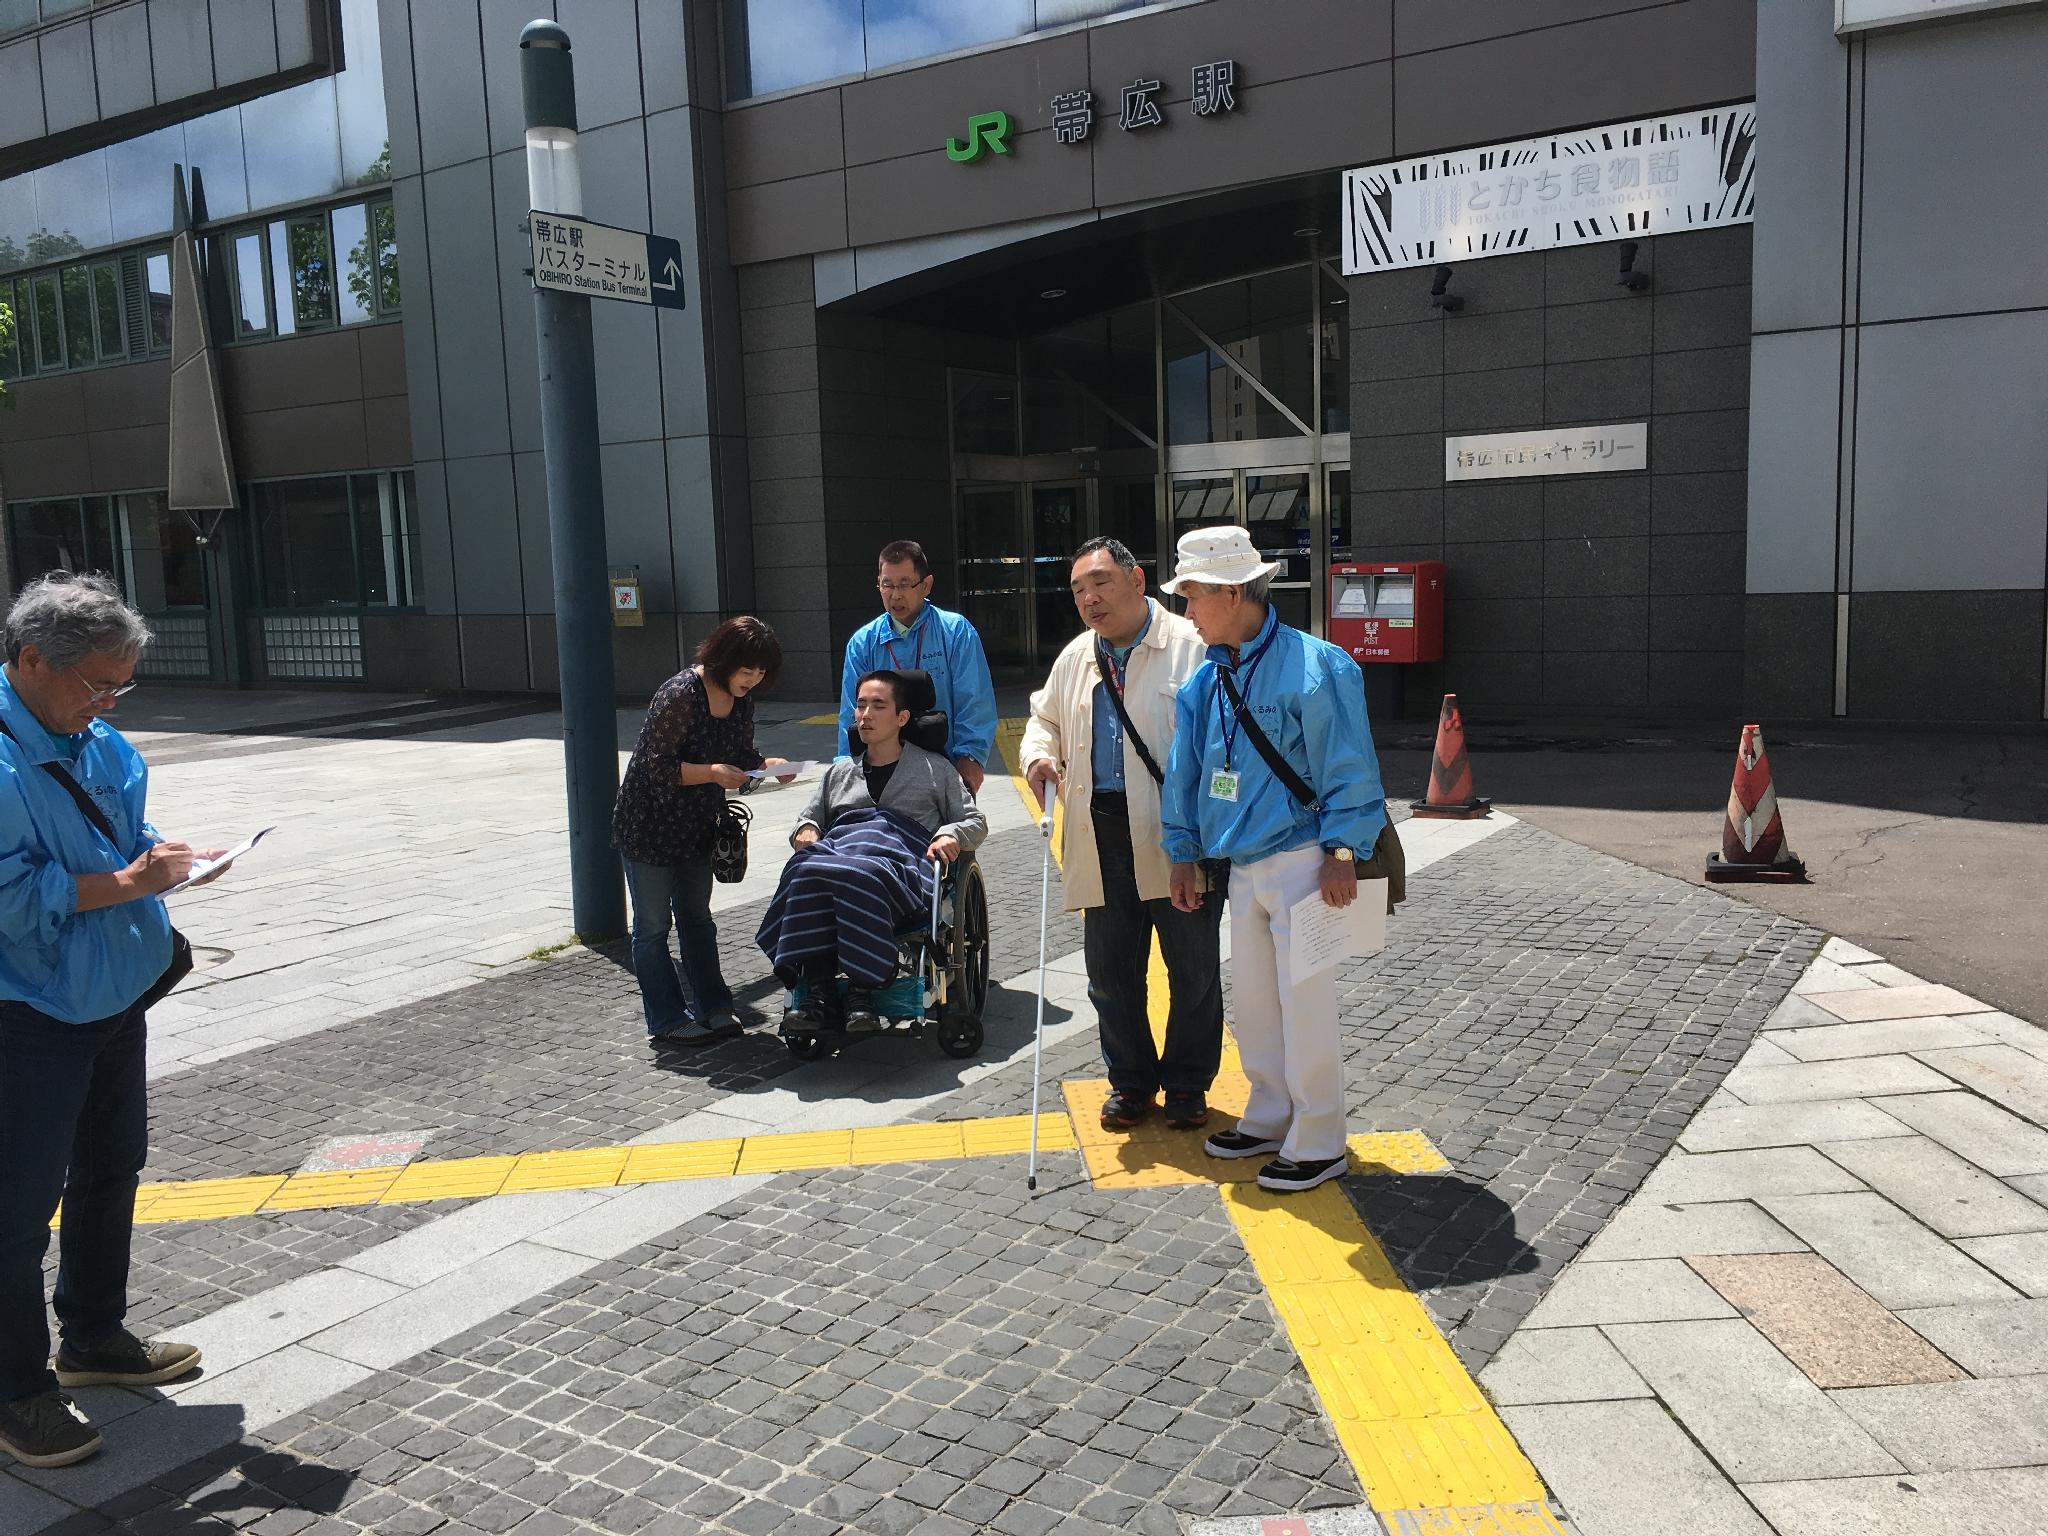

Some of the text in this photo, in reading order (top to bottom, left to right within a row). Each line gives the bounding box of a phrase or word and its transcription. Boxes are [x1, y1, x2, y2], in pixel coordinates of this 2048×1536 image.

[946, 60, 1234, 162] JR 帯広駅
[1468, 151, 1679, 210] とかち食物語
[1467, 186, 1679, 225] TOKACHI SHOKU MONOGATARI
[536, 219, 584, 248] 帯広駅
[540, 247, 646, 282] バスターミナル
[540, 269, 648, 297] OBIHIRO Station Bus Terminal
[1363, 637, 1379, 645] POST
